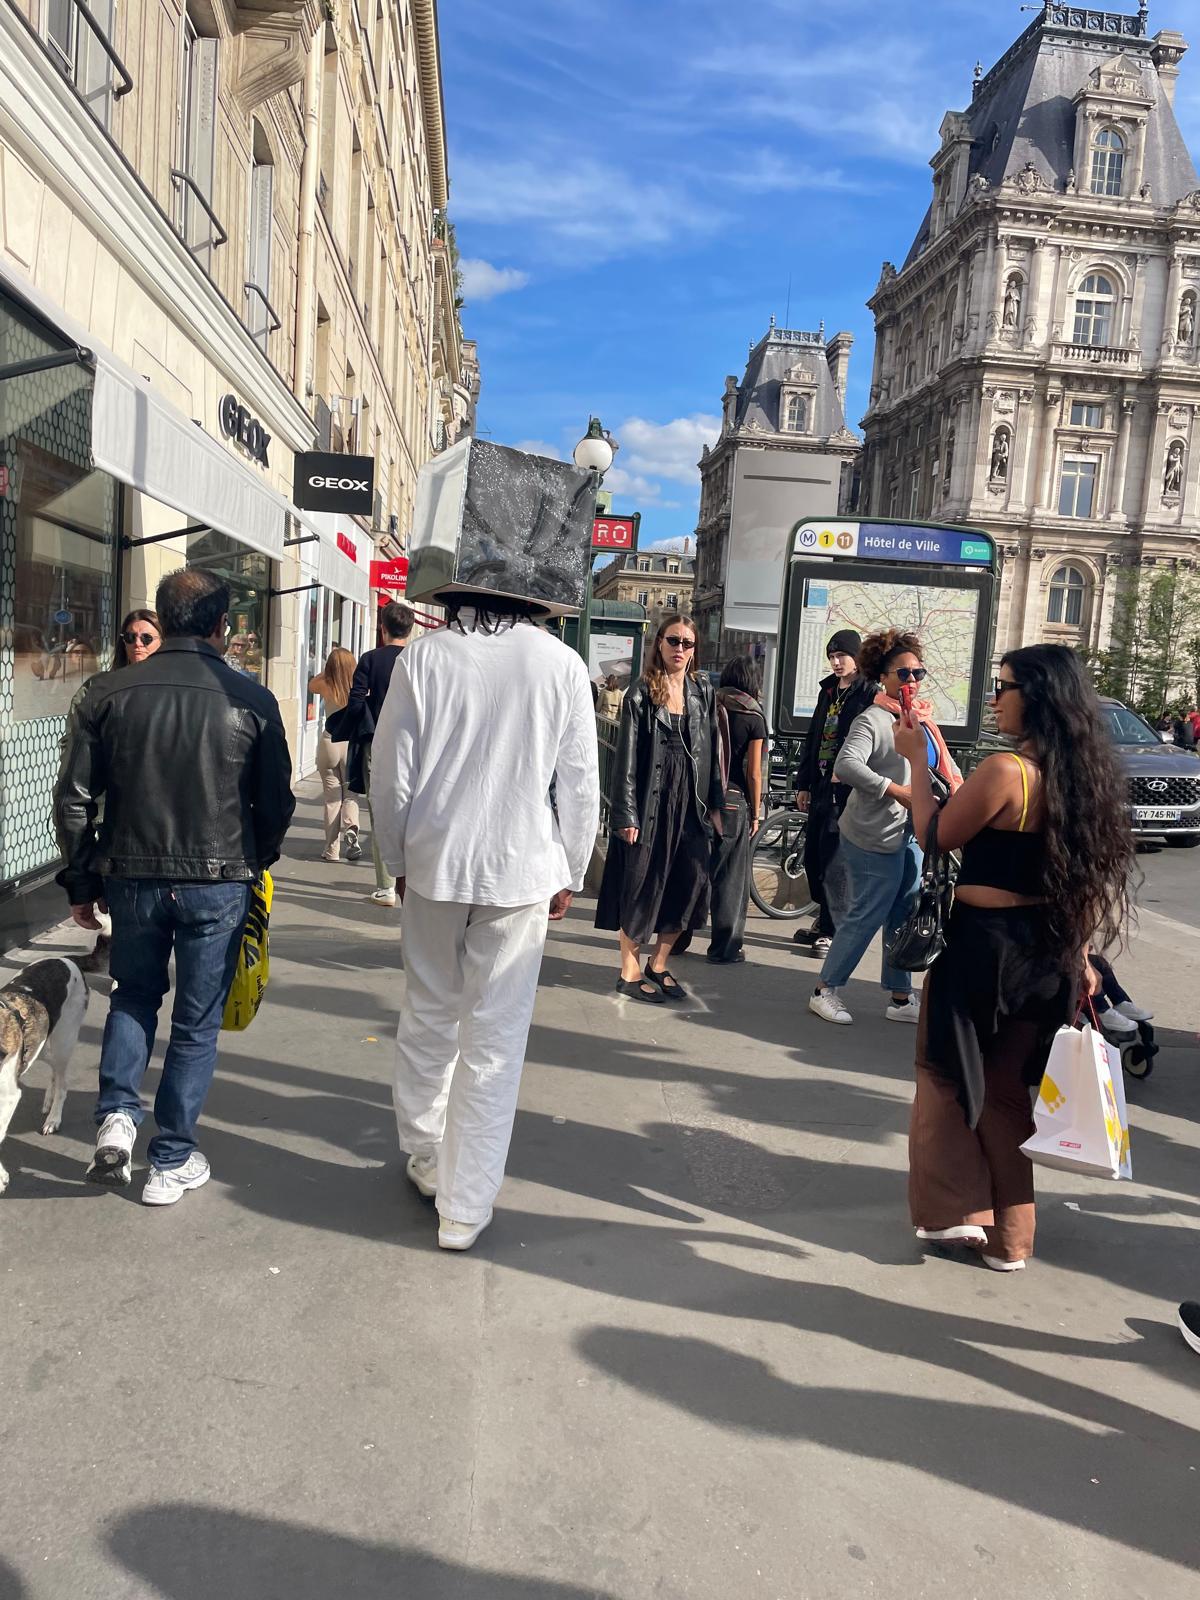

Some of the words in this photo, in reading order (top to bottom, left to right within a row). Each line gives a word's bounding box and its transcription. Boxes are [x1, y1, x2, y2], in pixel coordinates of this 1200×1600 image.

[219, 394, 271, 468] GEOX
[308, 475, 369, 492] GEOX
[594, 523, 627, 544] RO
[839, 536, 850, 546] 11
[864, 536, 895, 548] Hôtel
[898, 538, 912, 550] de
[915, 539, 940, 552] Ville
[380, 573, 407, 582] PIKOLIN
